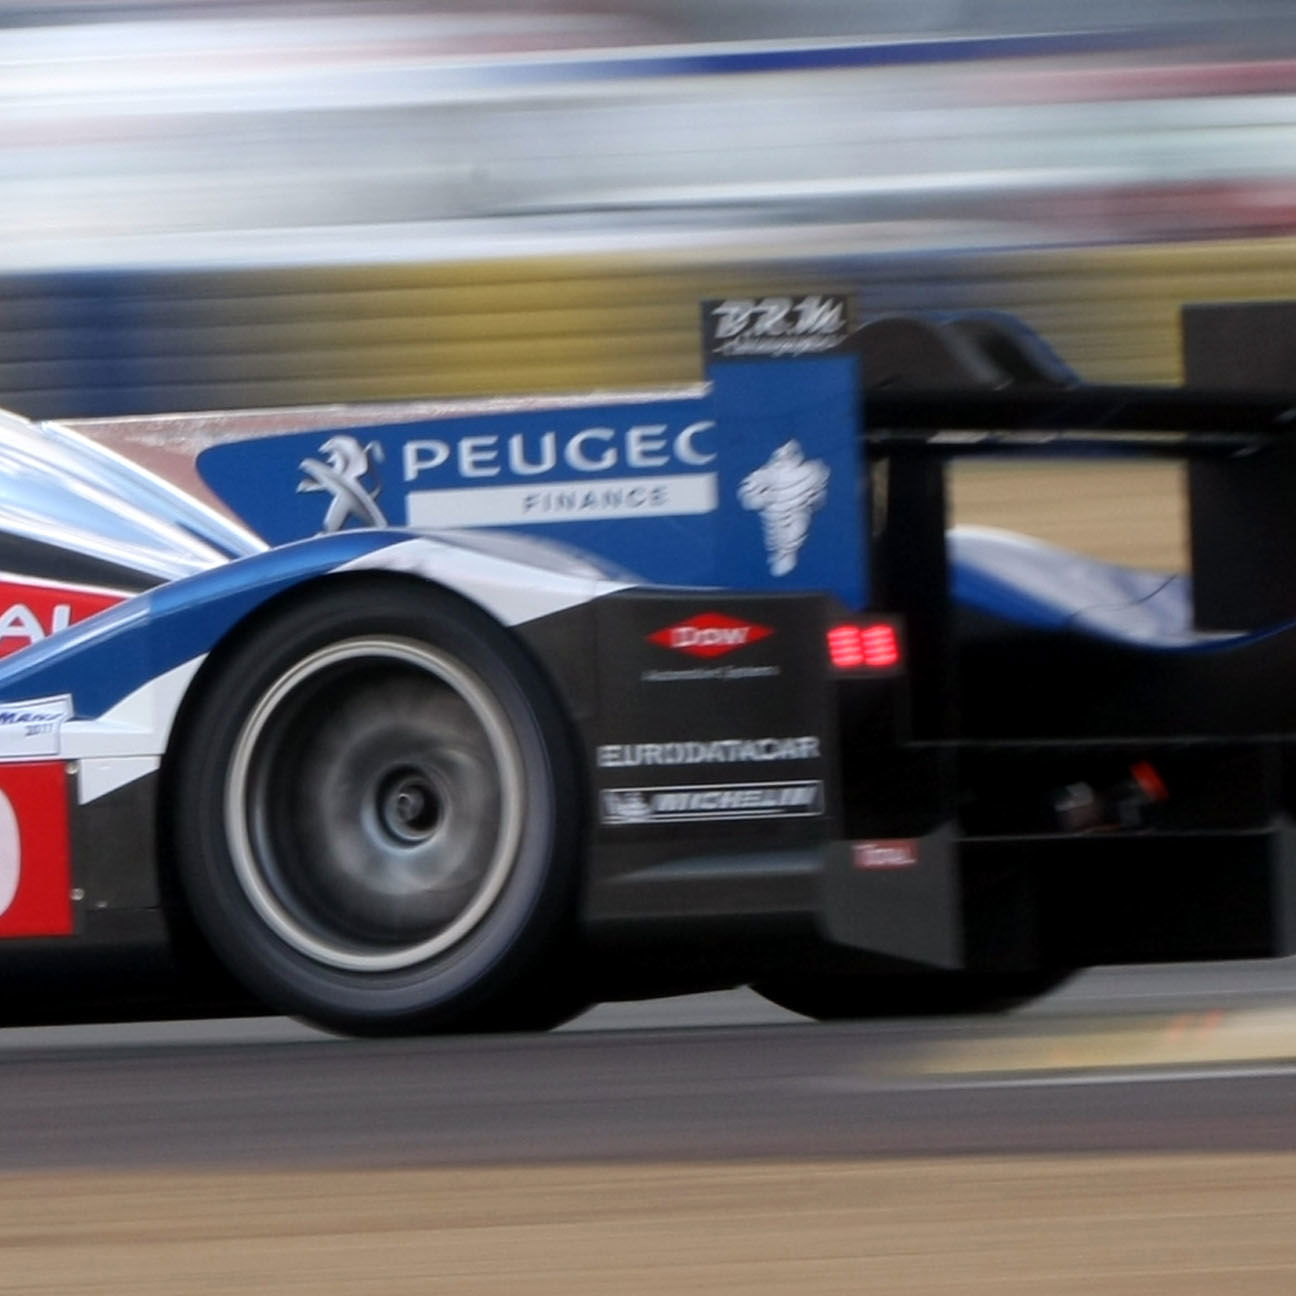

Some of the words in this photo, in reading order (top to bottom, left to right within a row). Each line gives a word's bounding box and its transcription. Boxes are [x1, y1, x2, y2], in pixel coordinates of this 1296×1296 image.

[403, 420, 717, 482] PEUGEO
[523, 485, 669, 513] FINANCE
[597, 736, 820, 767] EURODATACAR
